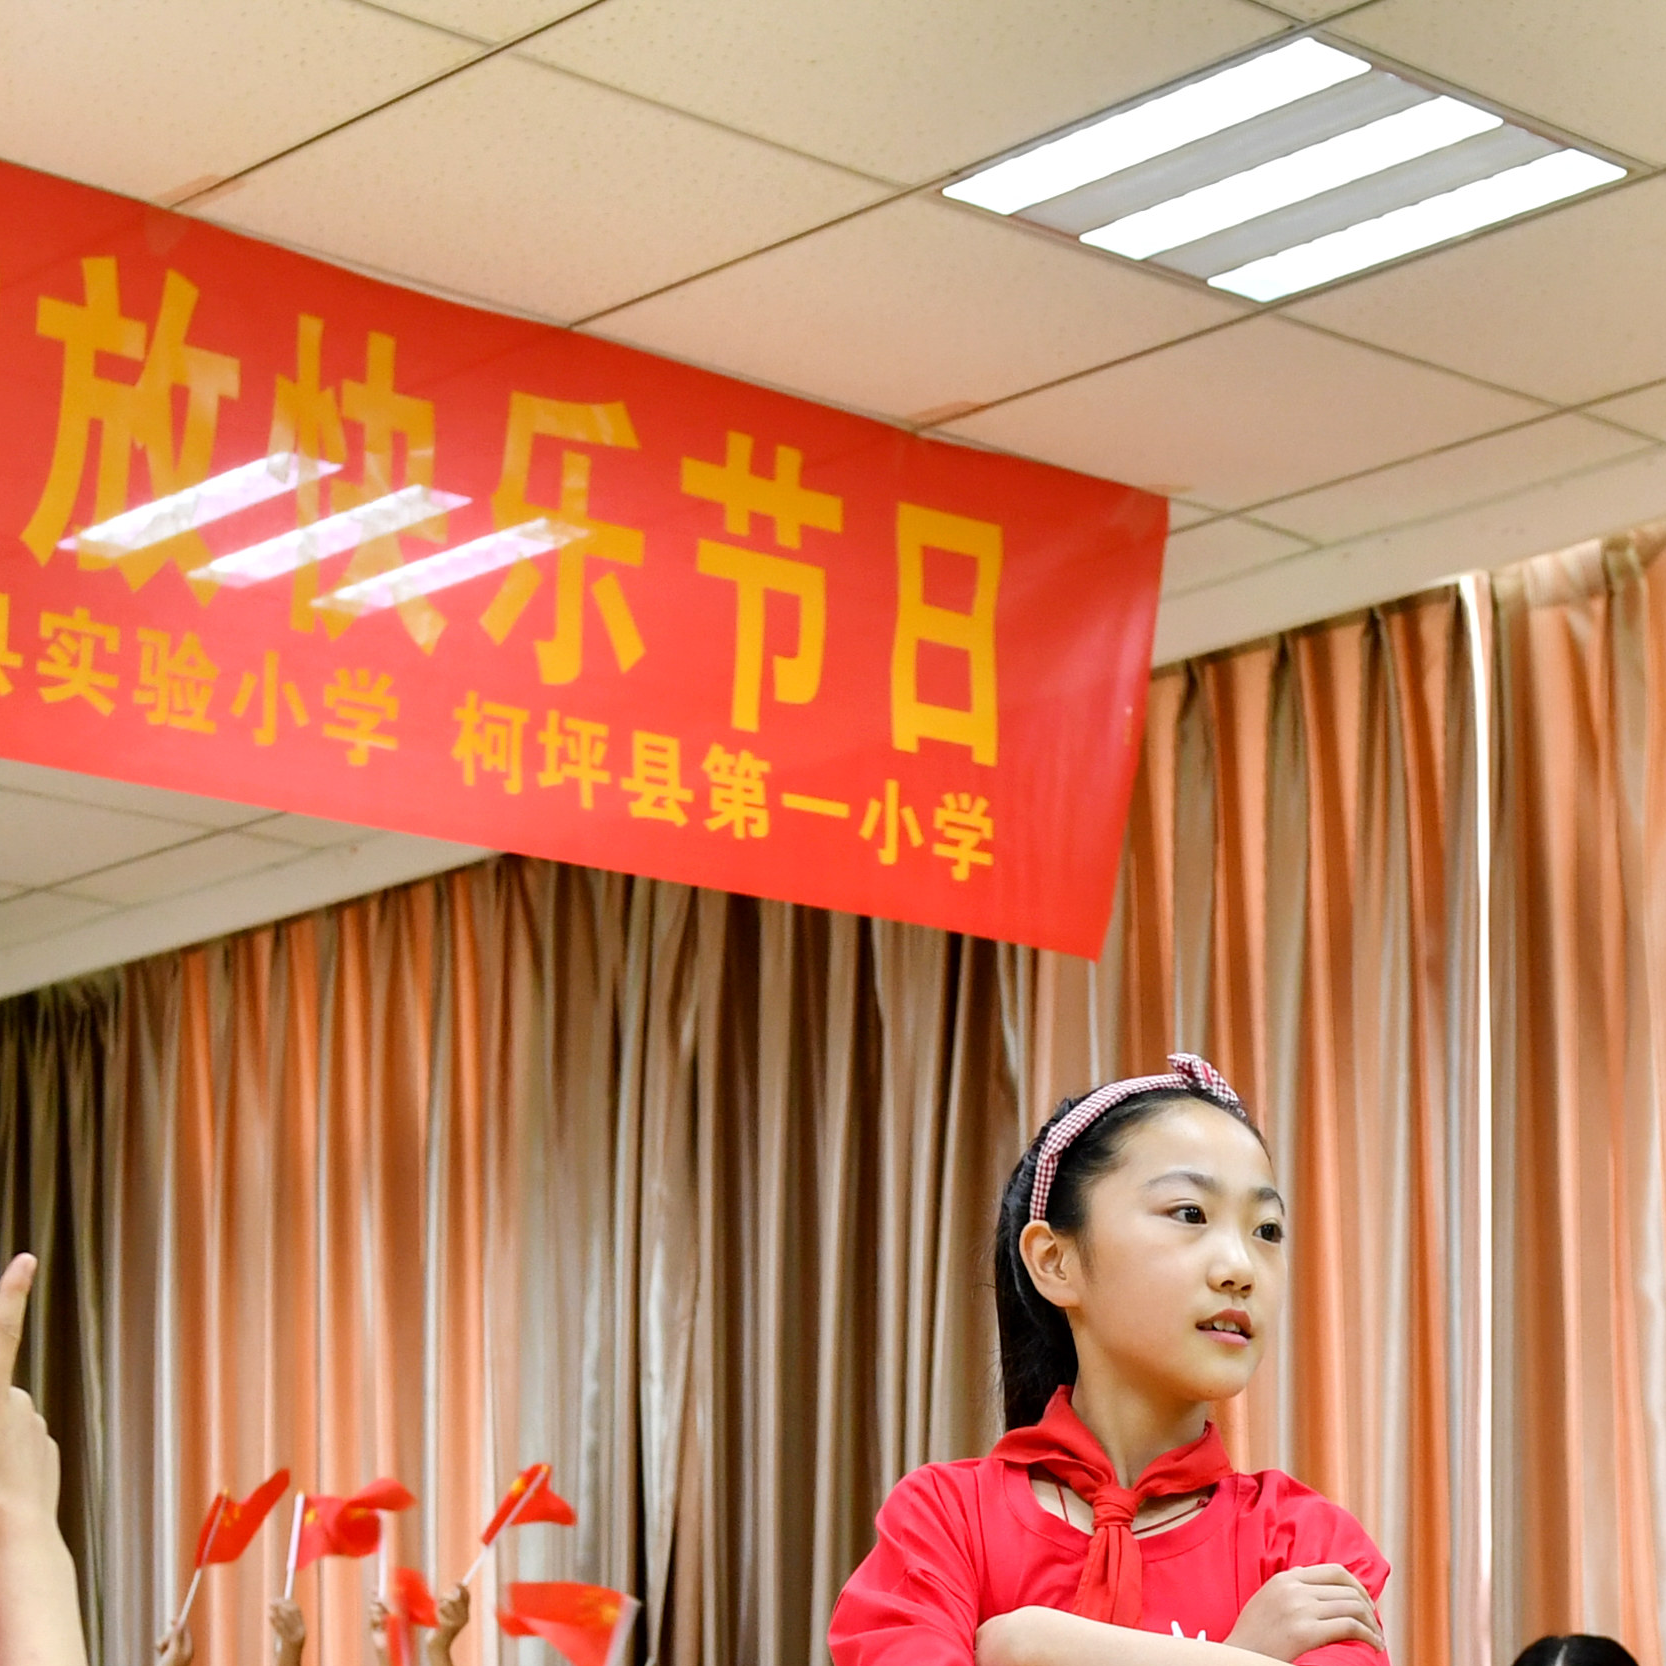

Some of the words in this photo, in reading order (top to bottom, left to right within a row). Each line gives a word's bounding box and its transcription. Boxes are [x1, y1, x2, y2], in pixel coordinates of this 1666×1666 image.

[451, 690, 994, 882] 柯坪县第一小学
